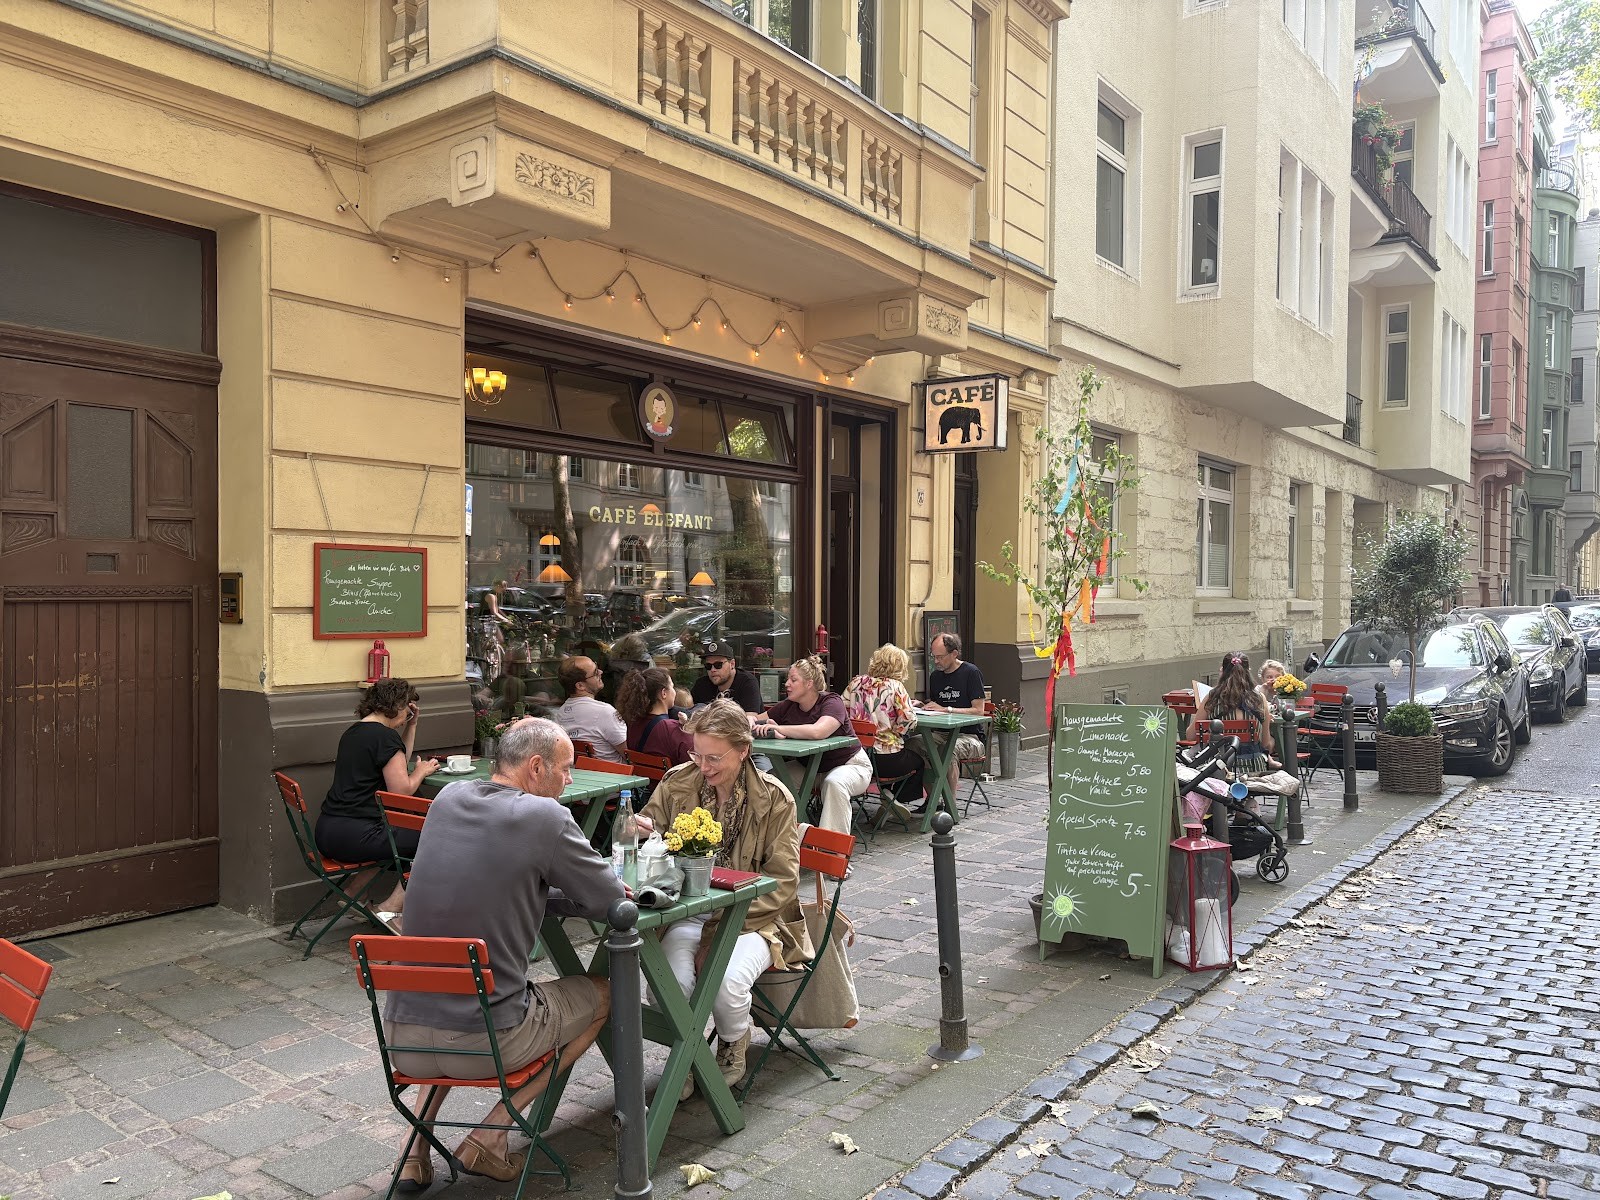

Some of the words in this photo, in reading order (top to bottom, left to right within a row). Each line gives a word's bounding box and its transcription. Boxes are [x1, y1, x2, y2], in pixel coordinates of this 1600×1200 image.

[930, 382, 994, 406] CAFÉ
[589, 505, 636, 525] CAFÉ
[643, 511, 714, 530] ELEFANT
[1080, 730, 1131, 743] Limonade
[1056, 810, 1085, 830] Aperol
[1055, 843, 1077, 856] Tinto
[1078, 847, 1088, 856] de
[1090, 843, 1117, 859] Verano
[1092, 875, 1120, 889] Orange
